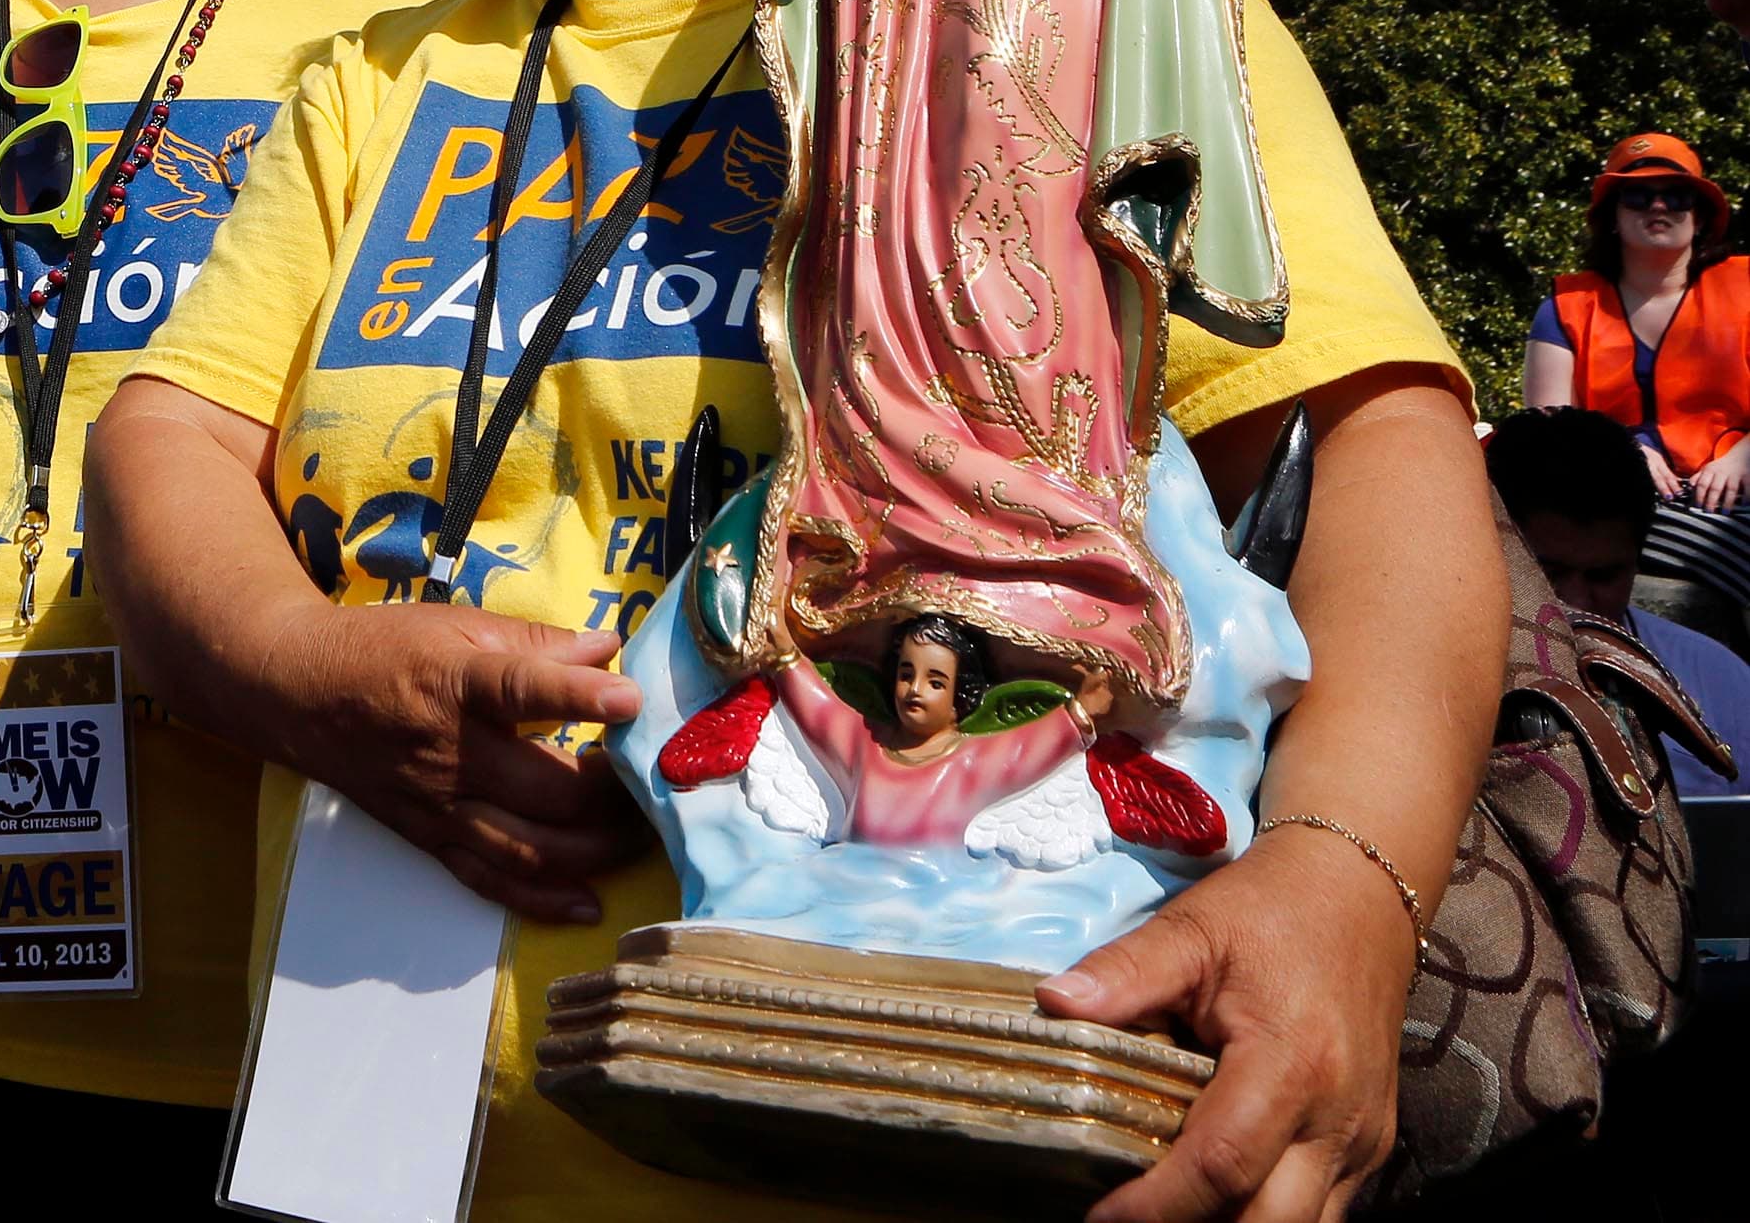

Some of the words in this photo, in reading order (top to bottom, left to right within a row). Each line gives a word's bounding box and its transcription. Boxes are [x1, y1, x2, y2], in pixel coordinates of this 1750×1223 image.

[406, 123, 718, 243] PAZ
[359, 256, 434, 341] en
[56, 720, 100, 758] IS
[21, 816, 99, 829] CITIZENSHIP
[14, 944, 48, 970] 10,
[55, 942, 112, 966] 2013
